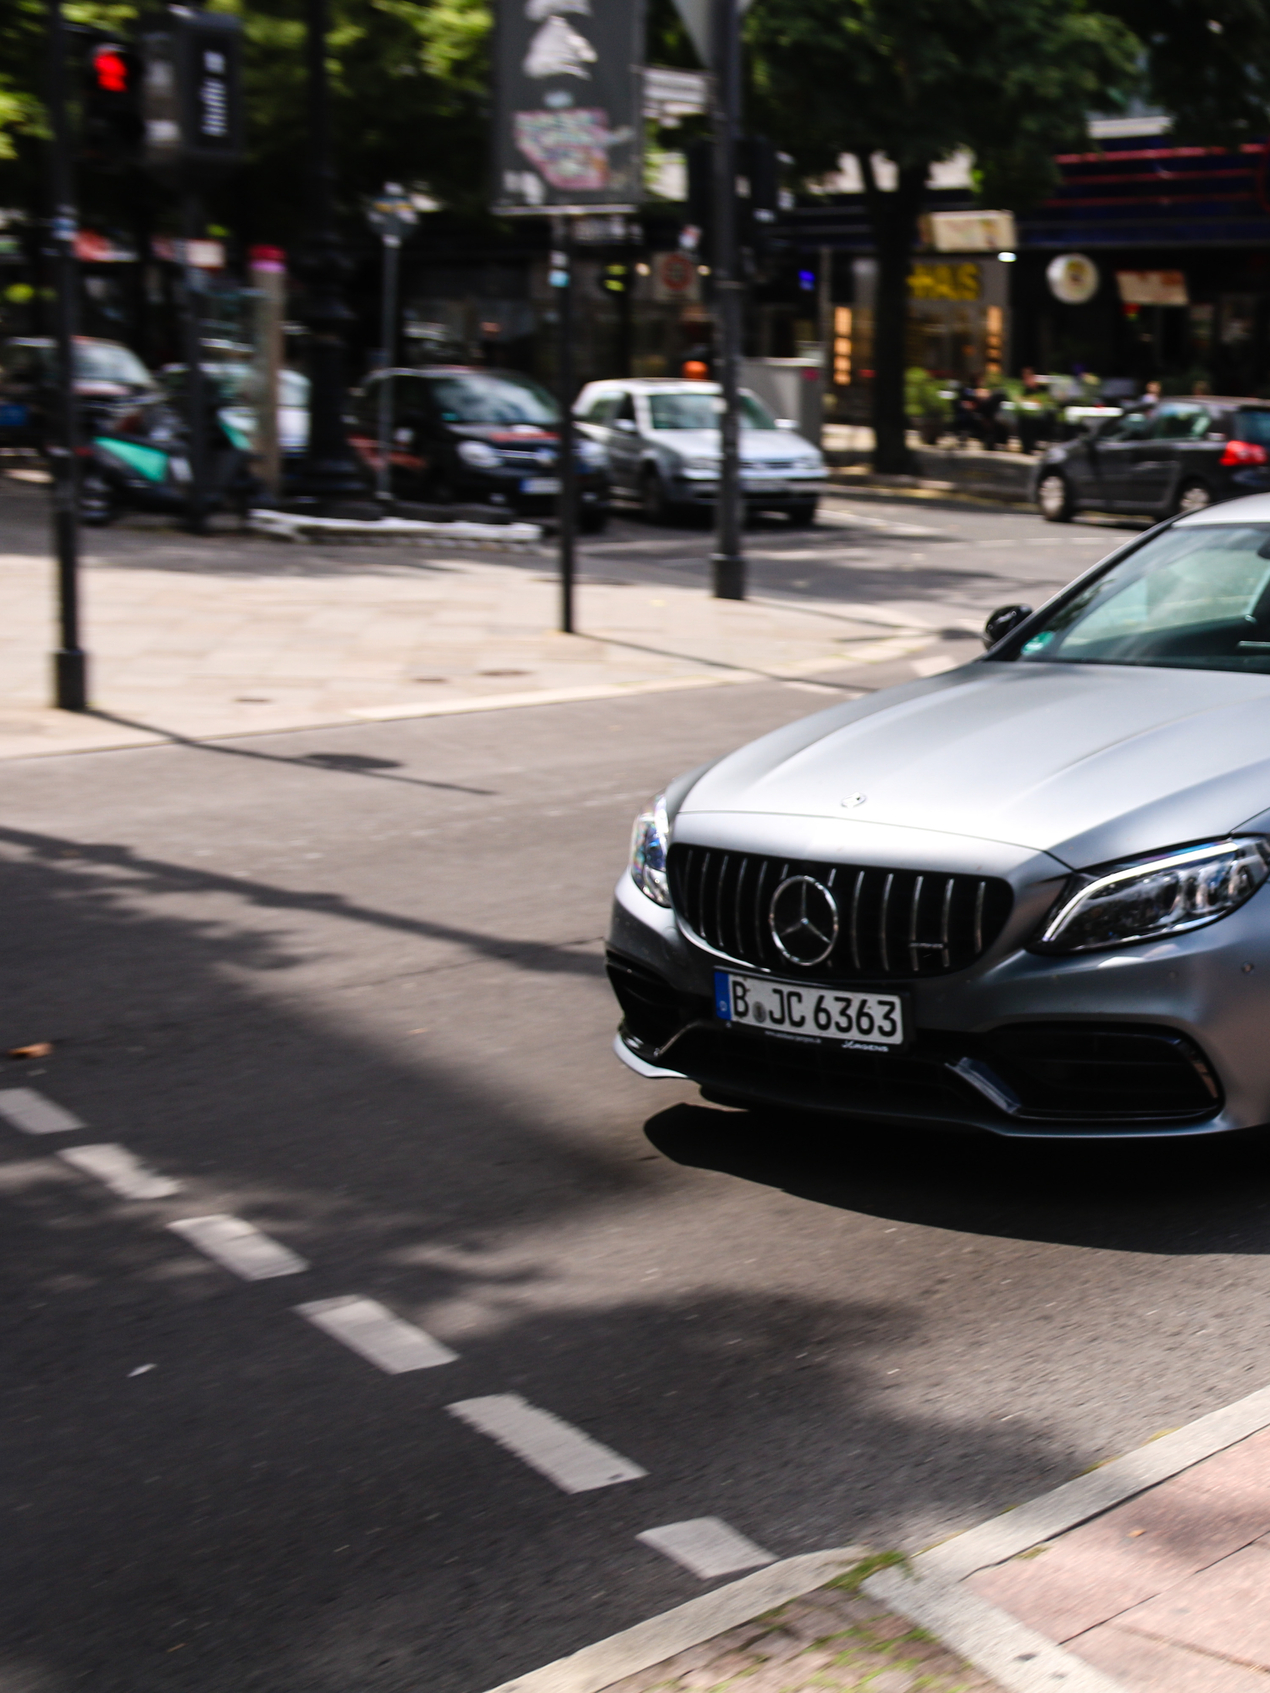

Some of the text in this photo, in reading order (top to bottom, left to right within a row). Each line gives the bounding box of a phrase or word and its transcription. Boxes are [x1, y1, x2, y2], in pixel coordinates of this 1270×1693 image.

[732, 980, 897, 1038] B JC 6363
